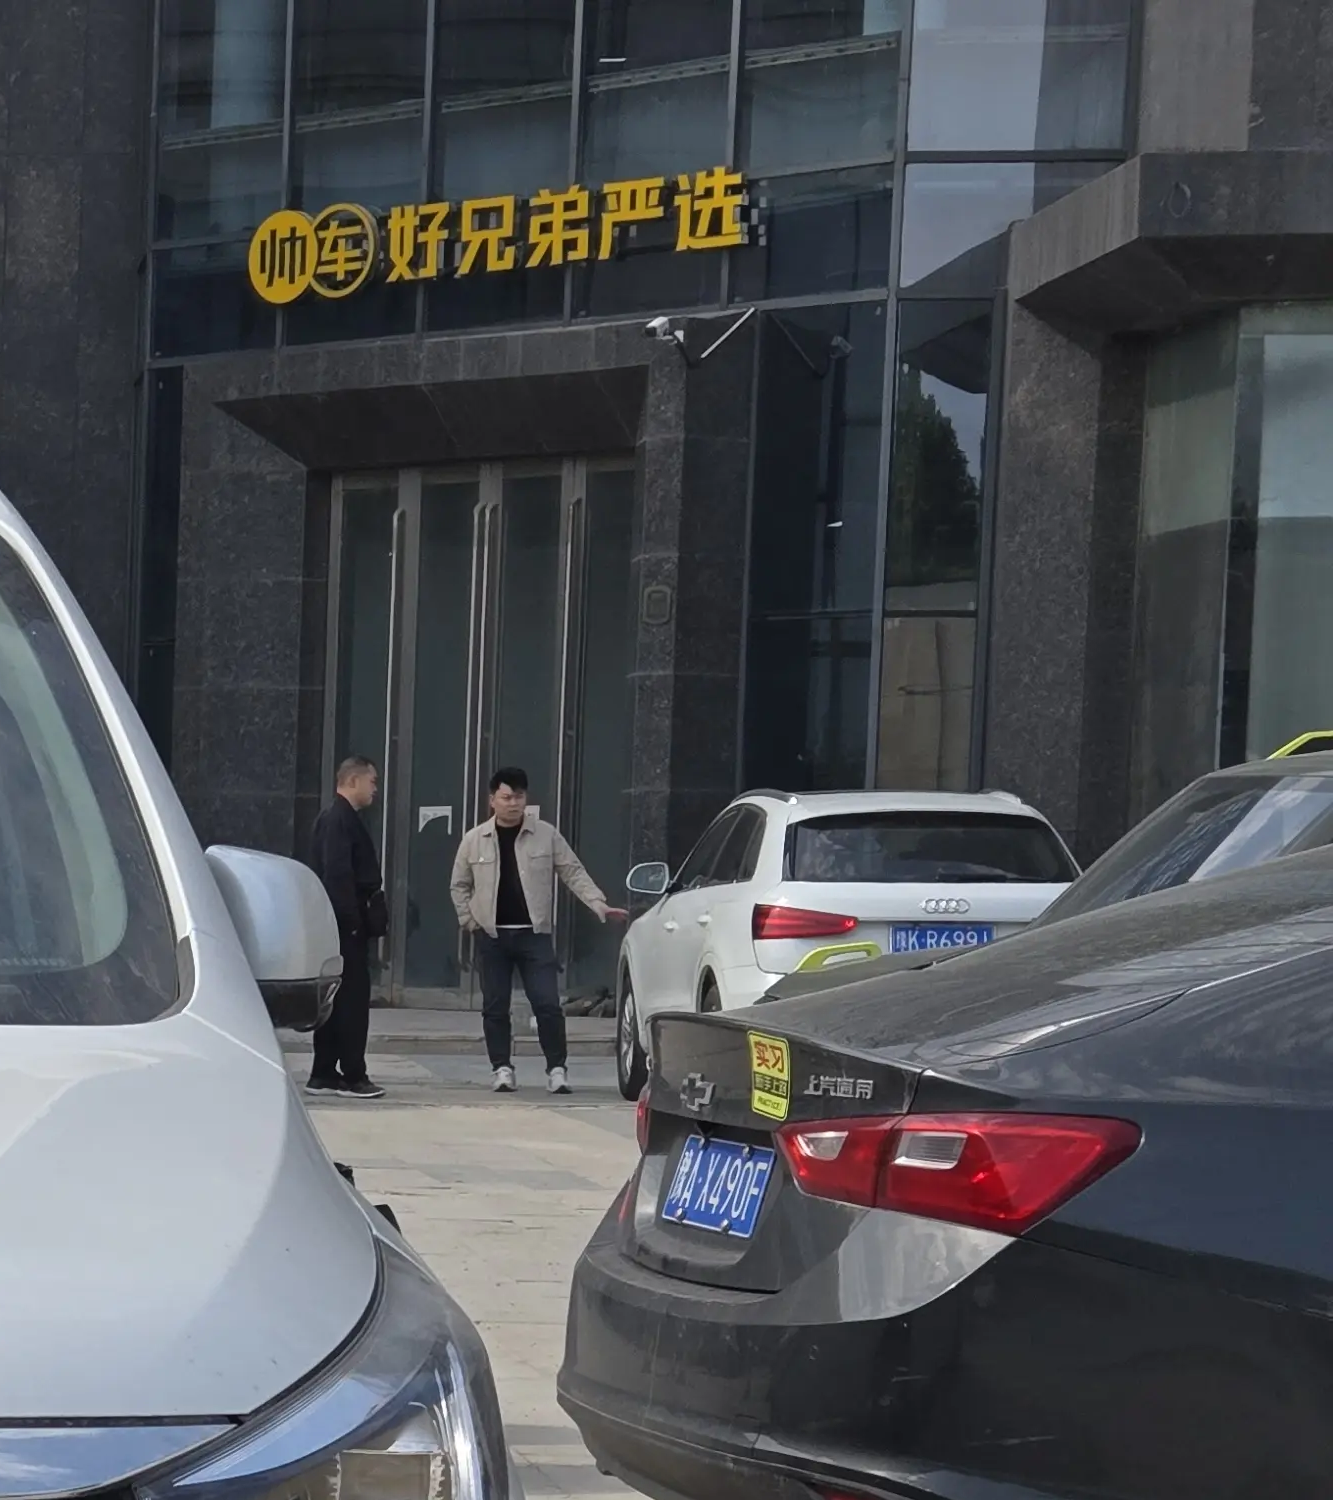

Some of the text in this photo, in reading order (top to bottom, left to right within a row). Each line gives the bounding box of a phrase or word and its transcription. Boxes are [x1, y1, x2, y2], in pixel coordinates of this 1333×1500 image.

[255, 166, 746, 292] 帅车 好兄弟严选
[754, 1041, 785, 1073] 实习
